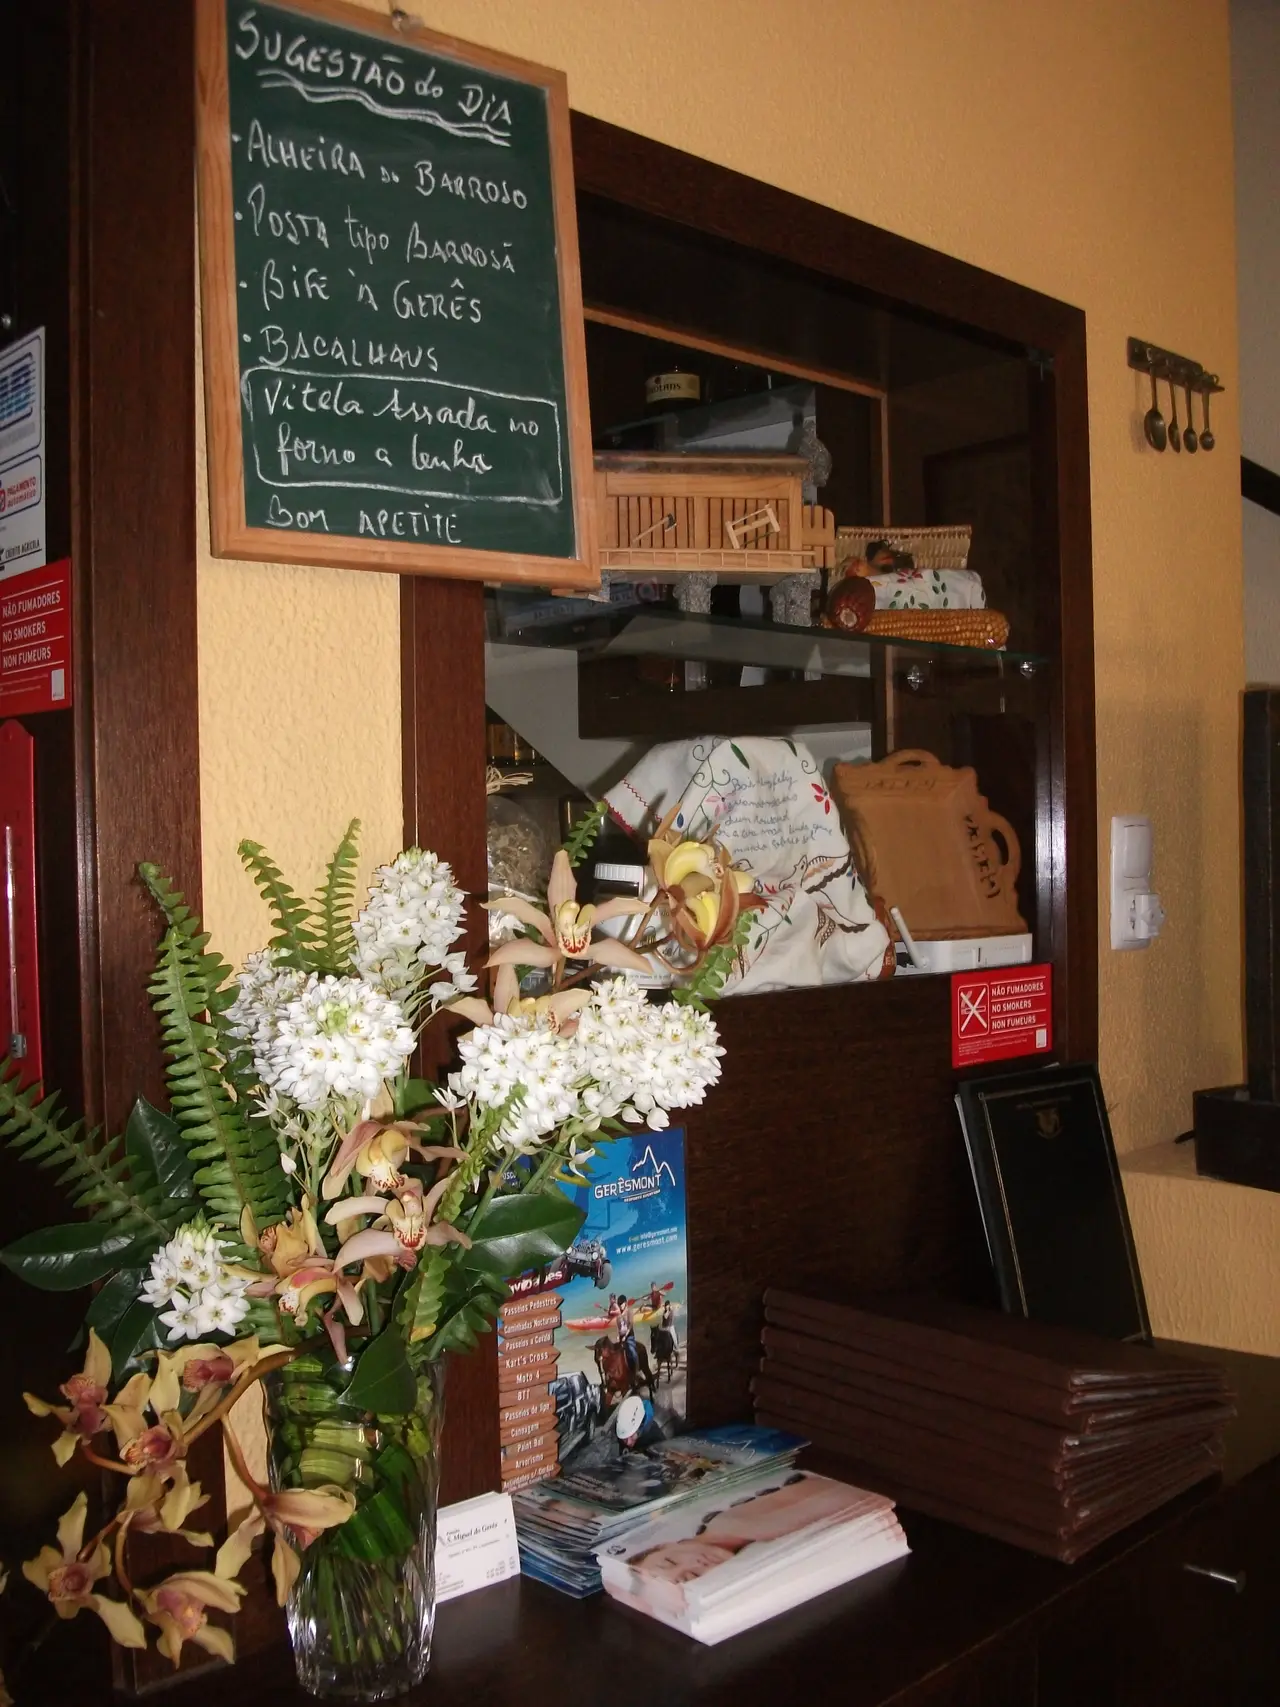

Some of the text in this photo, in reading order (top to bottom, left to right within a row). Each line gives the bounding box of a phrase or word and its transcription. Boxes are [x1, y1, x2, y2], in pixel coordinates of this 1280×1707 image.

[235, 9, 405, 96] SUGESTÃO
[415, 67, 444, 99] do
[415, 160, 528, 210] BARROSO
[247, 182, 516, 274] POSTA tipo BARROSÃ
[393, 279, 482, 323] GERÊS
[259, 325, 439, 373] BACALHAUS
[264, 381, 364, 416] Vitela
[510, 415, 540, 436] no
[276, 421, 494, 476] forno a lenha
[265, 495, 329, 533] BOM
[2, 590, 61, 618] NÃO FUMADORES
[2, 620, 46, 644] NO SMOKERS
[3, 646, 52, 669] NON FUMEURS
[991, 982, 1044, 997] NÃO FUMADORES
[991, 1000, 1032, 1013] NO SMOKERS
[991, 1015, 1036, 1030] NON FUMEURS
[594, 1174, 662, 1199] GERÊSMONT
[504, 1296, 557, 1316] Passeios Pedestres
[505, 1338, 529, 1351] Passeios
[529, 1351, 549, 1363] Cross
[516, 1370, 540, 1384] Moto 4
[517, 1388, 531, 1401] BTT
